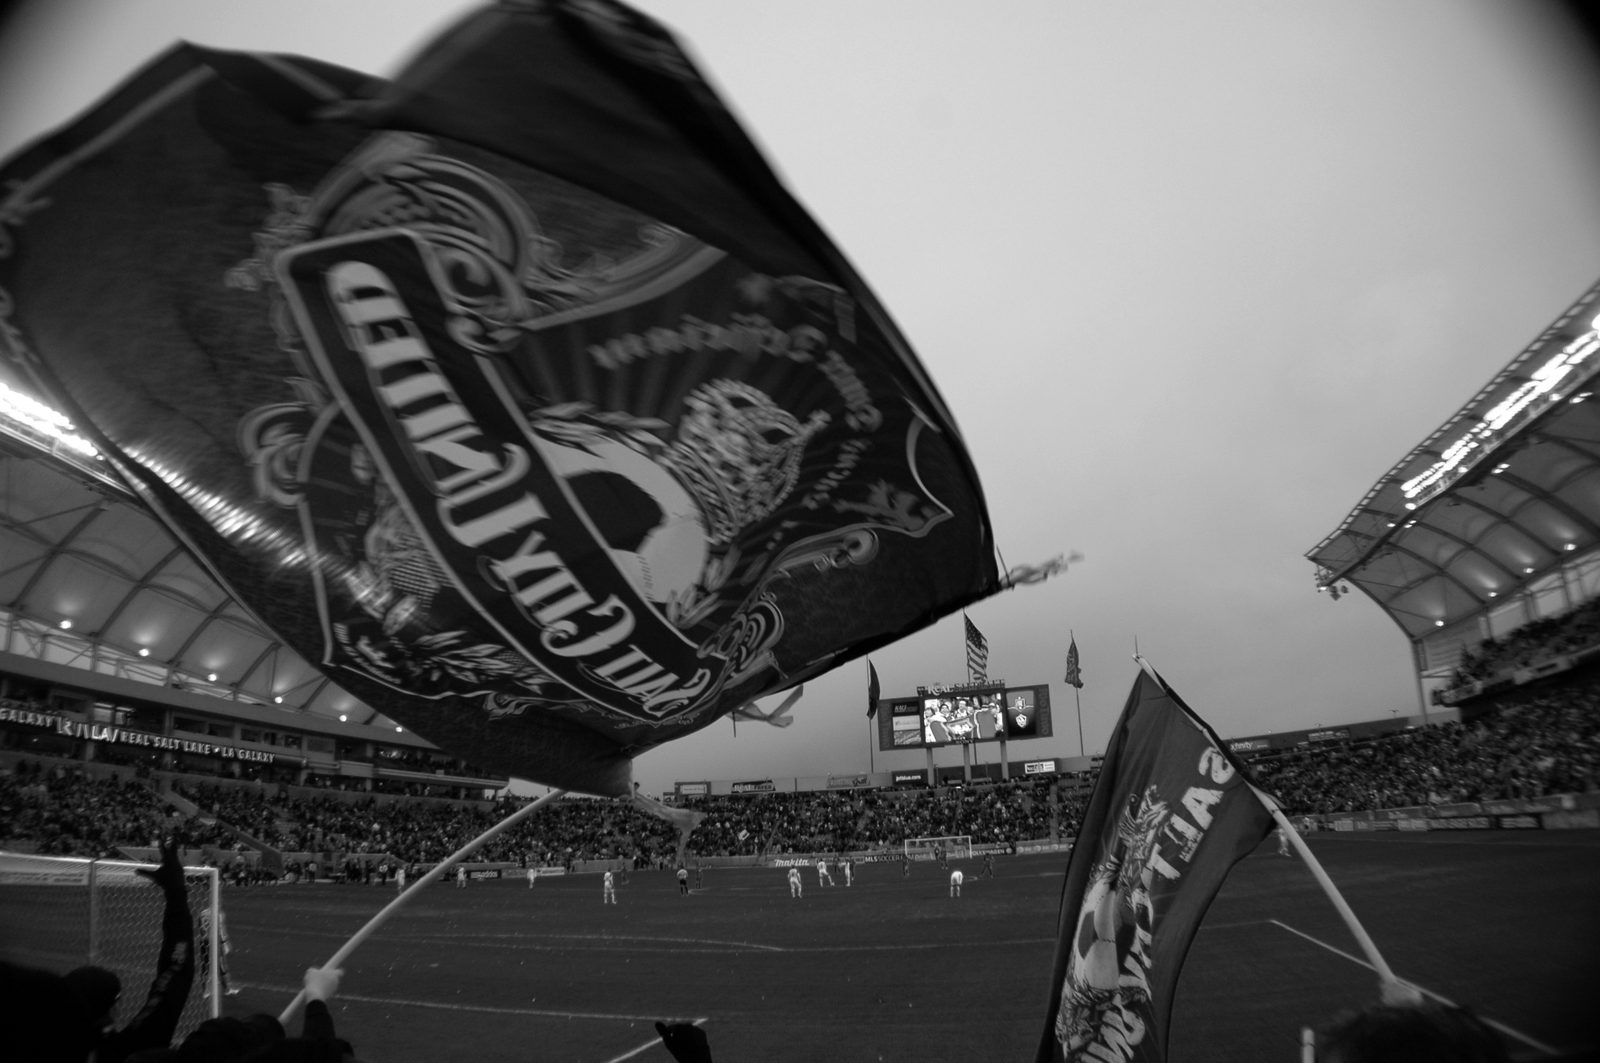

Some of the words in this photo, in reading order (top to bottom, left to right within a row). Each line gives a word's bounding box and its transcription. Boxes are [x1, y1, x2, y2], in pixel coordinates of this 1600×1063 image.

[120, 731, 150, 747] REAL
[153, 736, 180, 751] SALT
[183, 740, 212, 755] LAKE
[220, 746, 236, 759] LA
[237, 749, 277, 764] GALAXY
